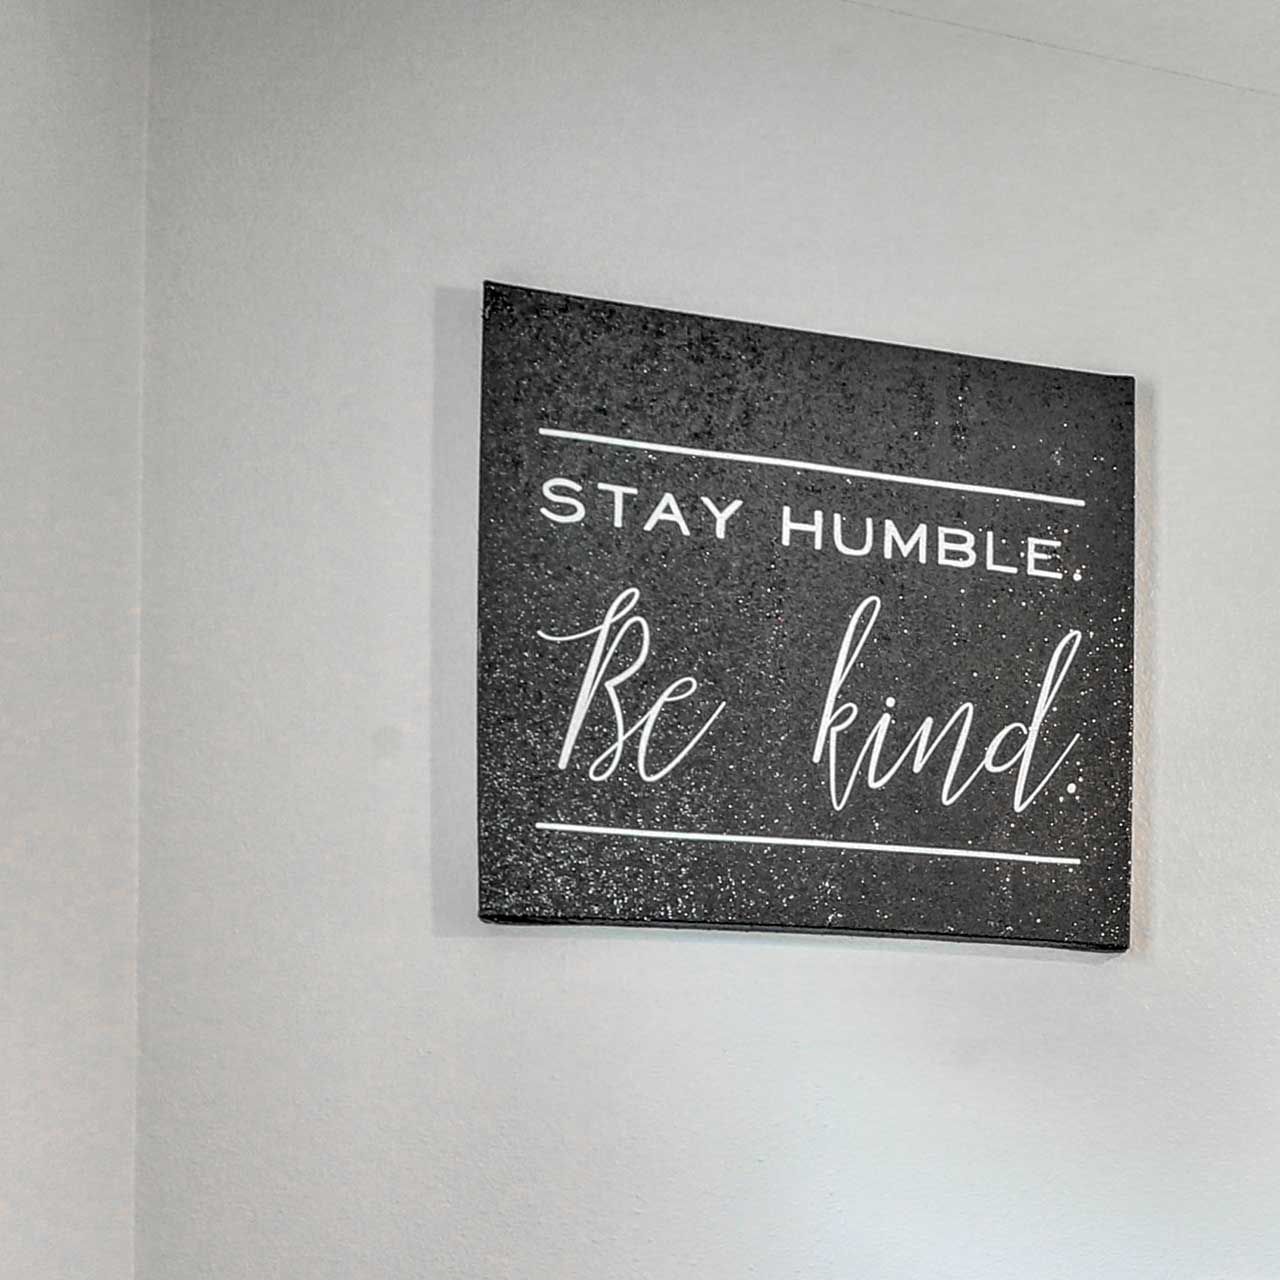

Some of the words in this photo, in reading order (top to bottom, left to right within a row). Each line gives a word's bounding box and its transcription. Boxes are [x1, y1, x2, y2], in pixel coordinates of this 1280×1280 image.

[540, 477, 744, 539] STAY
[780, 505, 1084, 582] HUMBLE.
[535, 587, 727, 781] Be
[812, 595, 1084, 813] kind.
